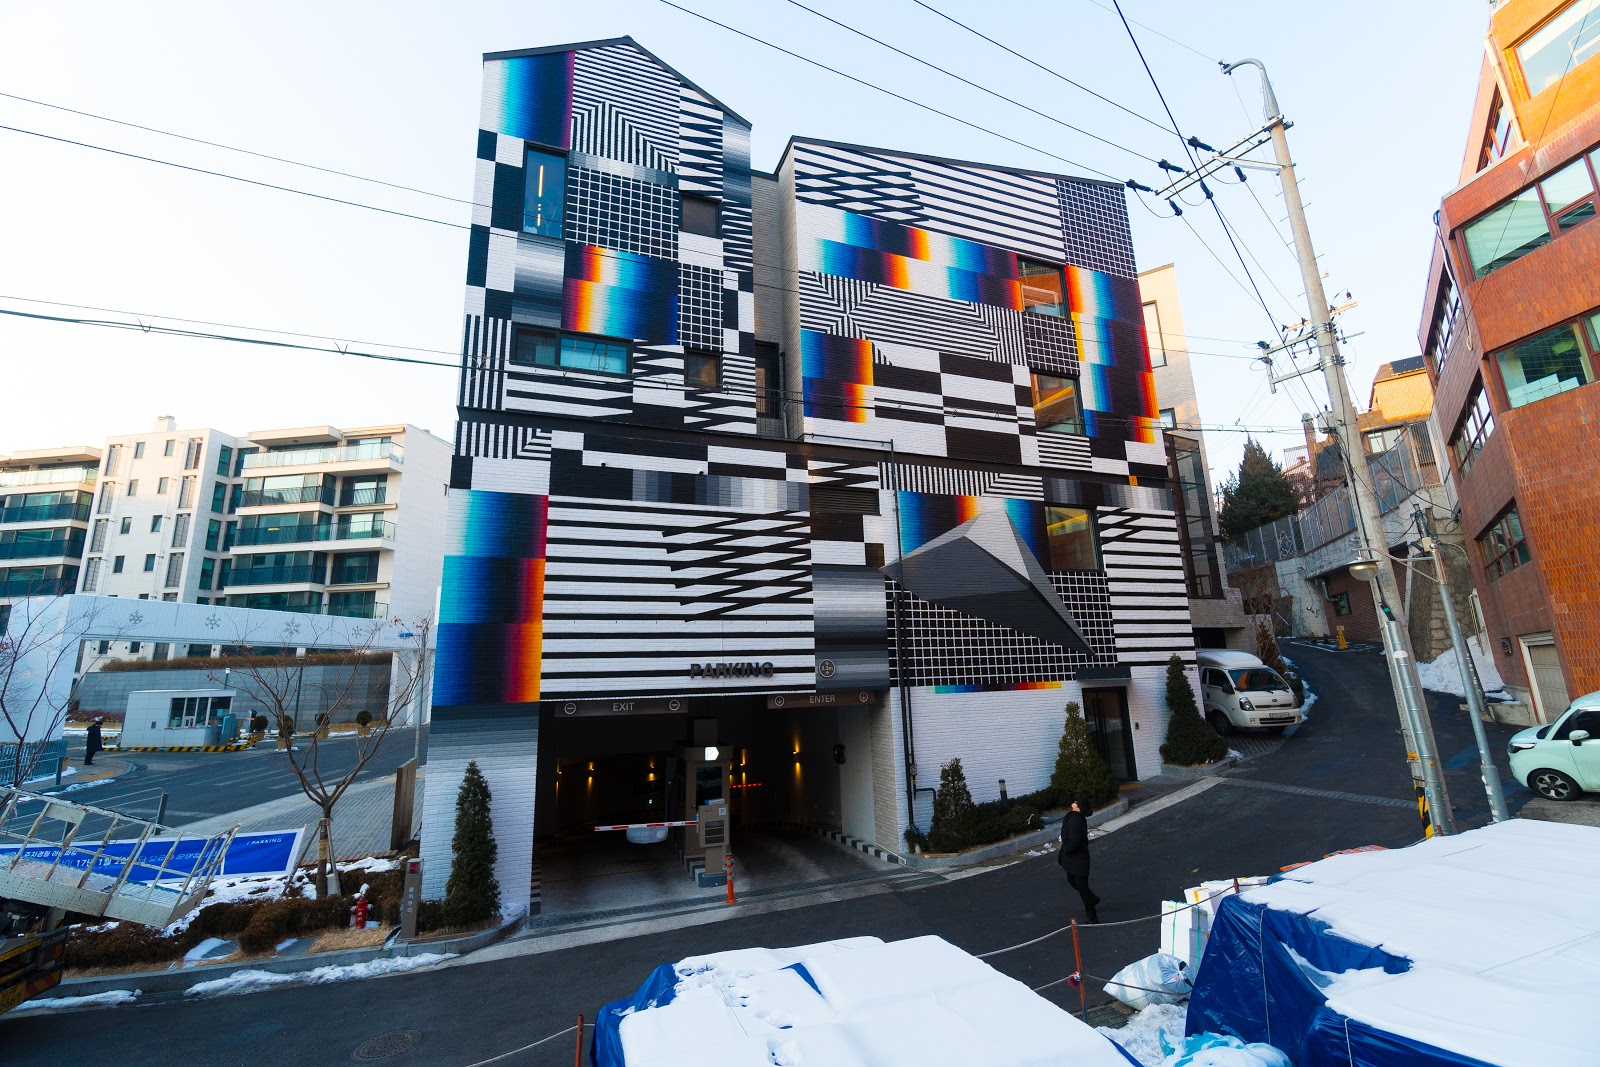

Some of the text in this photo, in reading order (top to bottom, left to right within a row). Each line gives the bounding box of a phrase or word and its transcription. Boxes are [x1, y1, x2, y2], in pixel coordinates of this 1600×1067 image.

[690, 661, 774, 679] PARKING
[809, 694, 836, 704] ENTER
[612, 702, 635, 711] EXIT
[250, 837, 282, 845] PARKING
